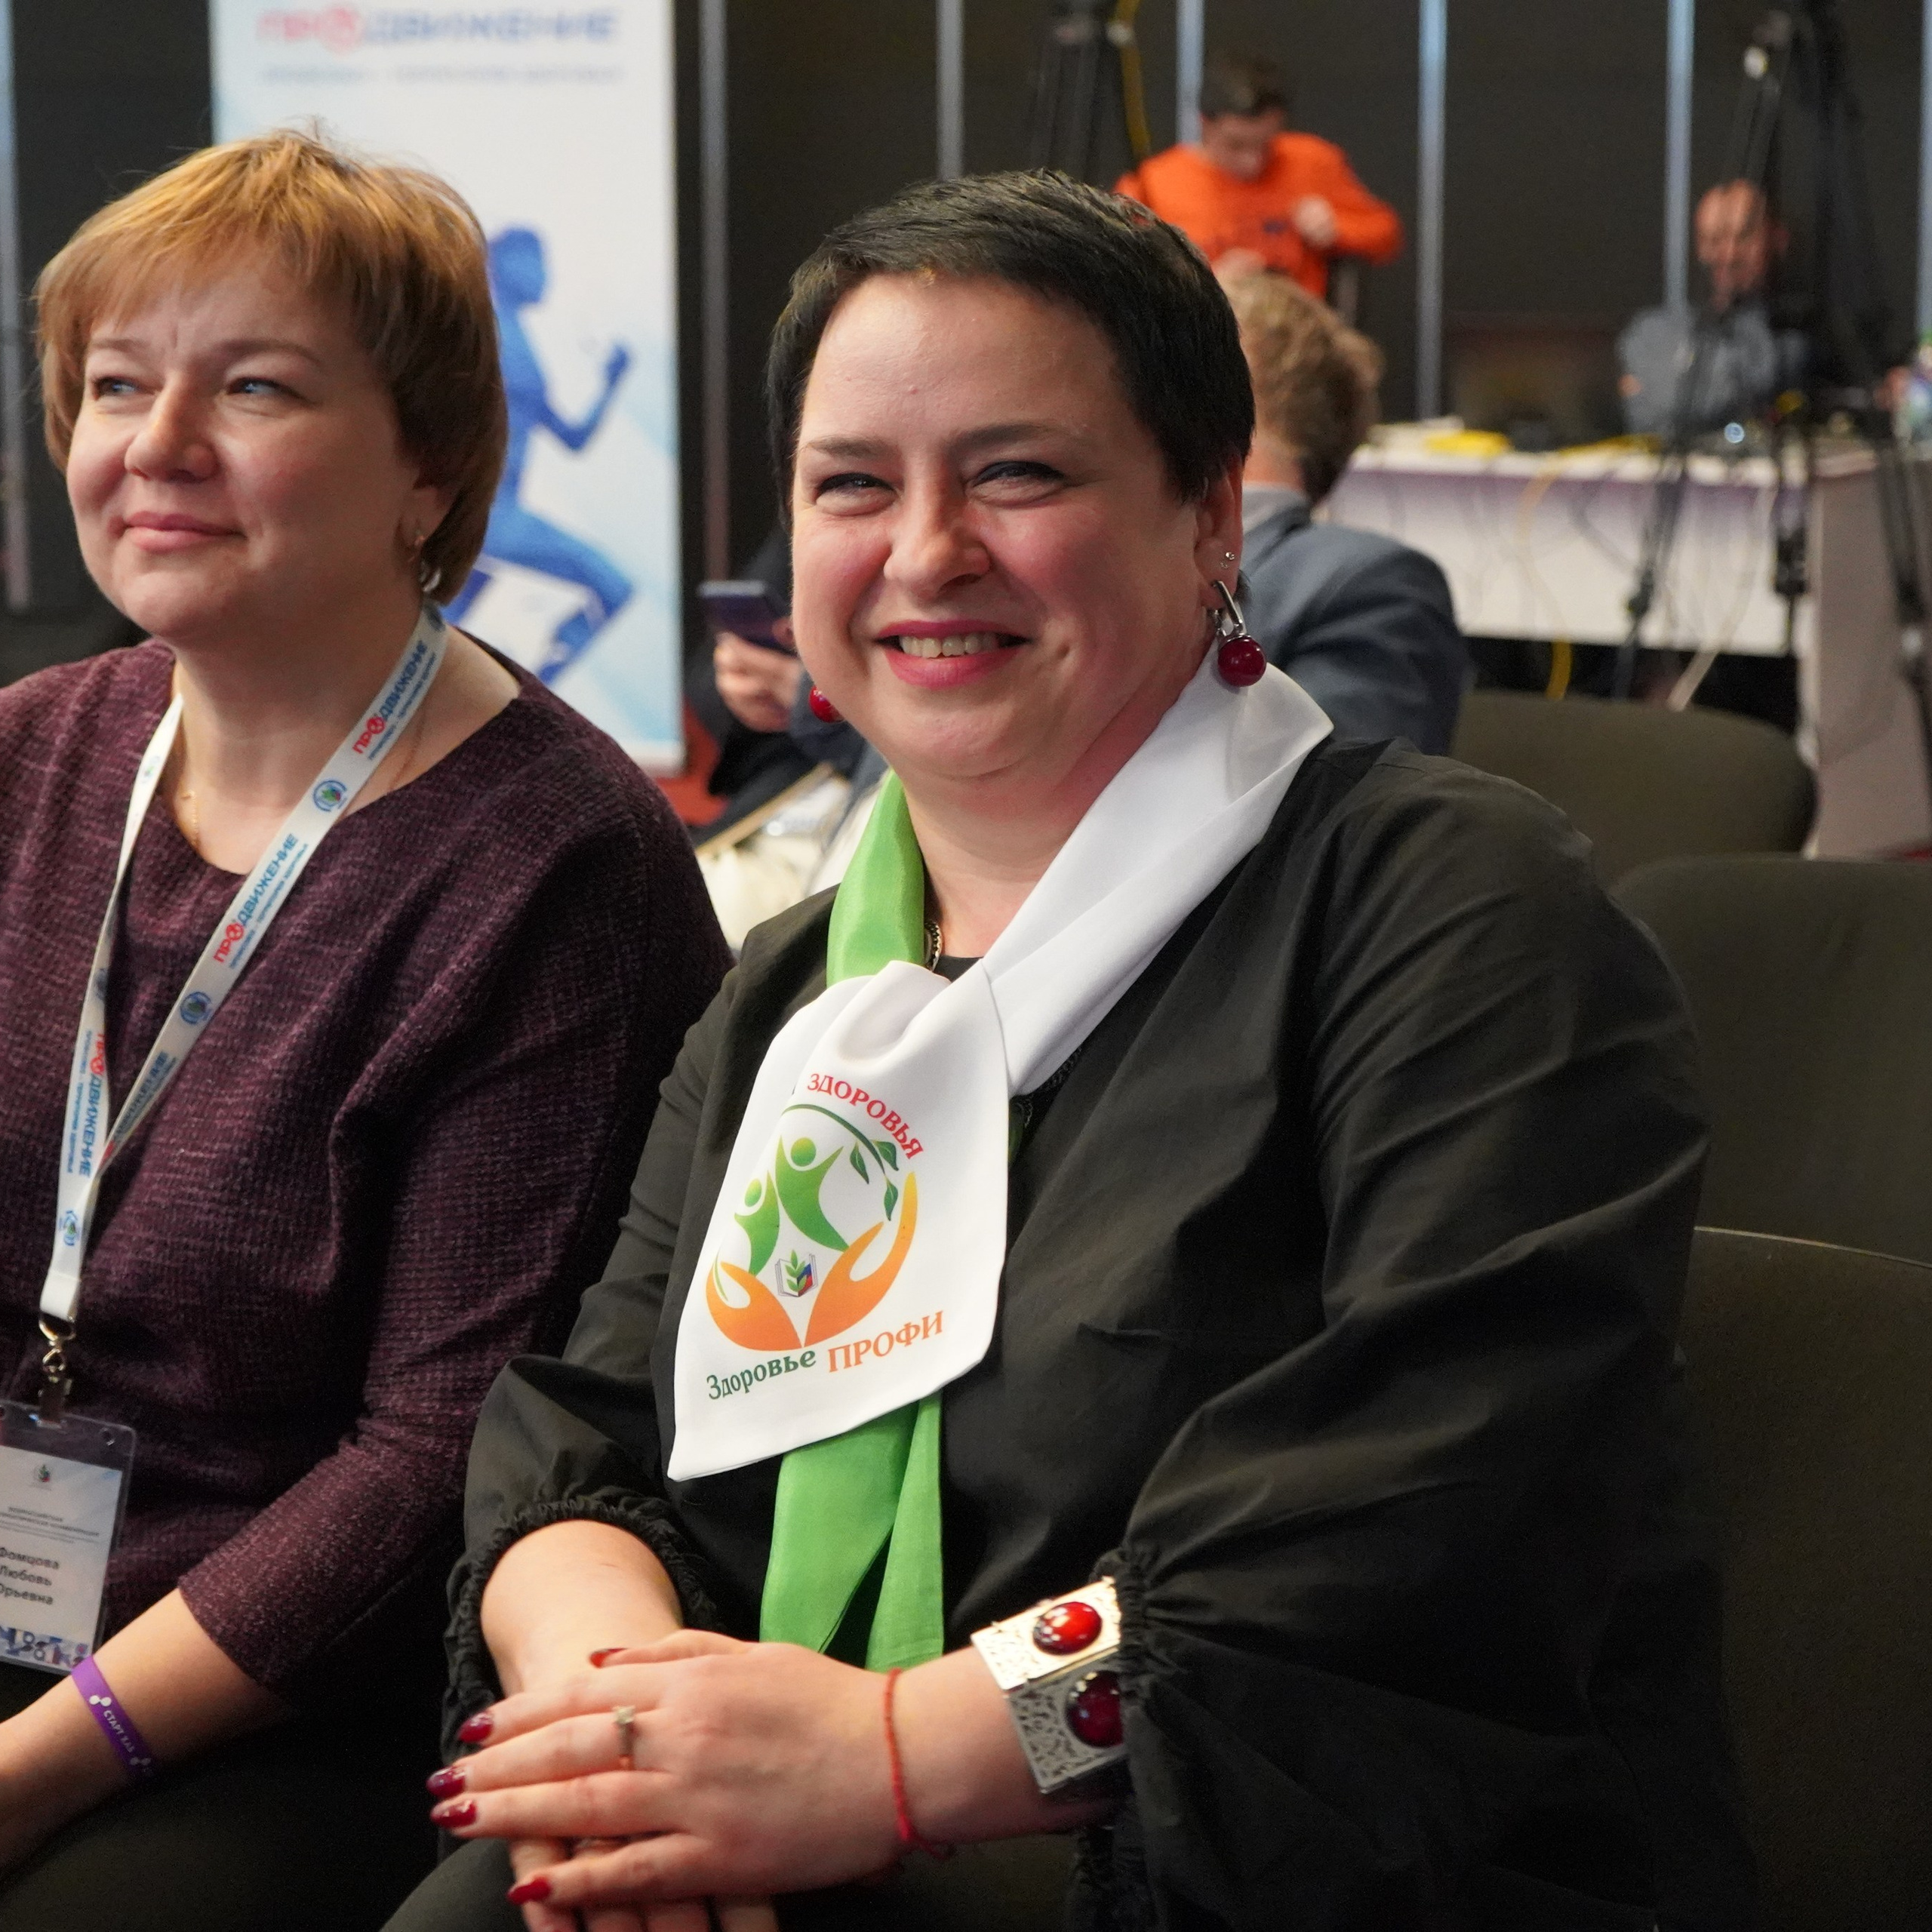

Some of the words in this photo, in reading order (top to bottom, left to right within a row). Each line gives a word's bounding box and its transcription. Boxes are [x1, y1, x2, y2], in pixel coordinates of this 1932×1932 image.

[213, 833, 298, 963] ПРОДВИЖЕНИЕ
[807, 1072, 924, 1160] ЗДОРОВЬЯ
[706, 1349, 817, 1401] Здоровье
[827, 1310, 944, 1374] ПРОФИ
